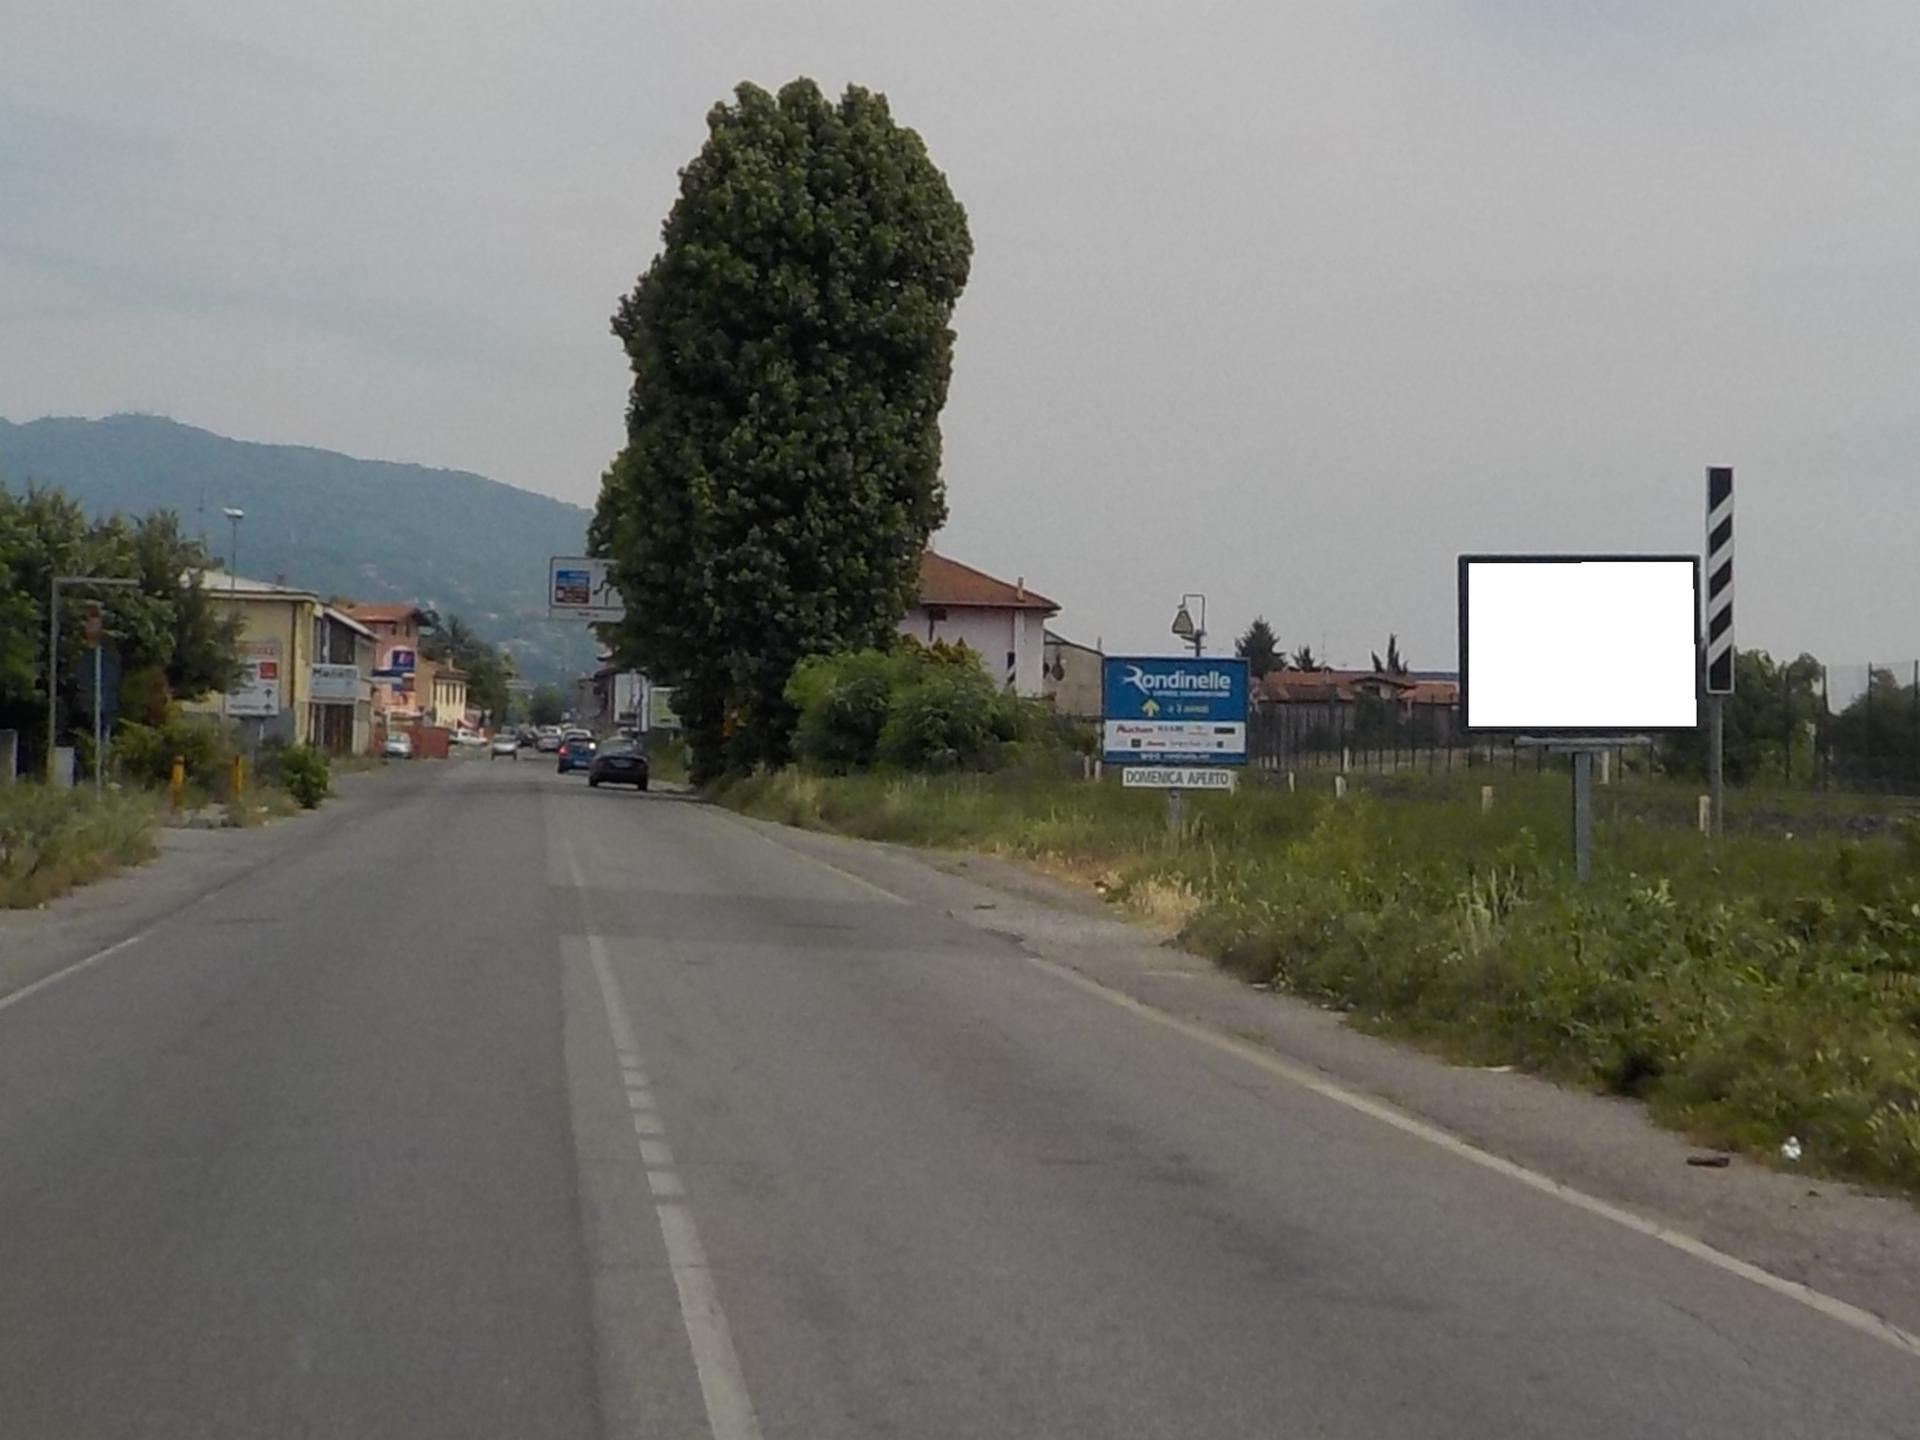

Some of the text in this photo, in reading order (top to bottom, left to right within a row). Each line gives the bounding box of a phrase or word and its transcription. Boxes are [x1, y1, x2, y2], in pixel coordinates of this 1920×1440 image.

[1122, 664, 1231, 695] Rondinelle
[1126, 770, 1229, 785] DOMENICA APERTO
